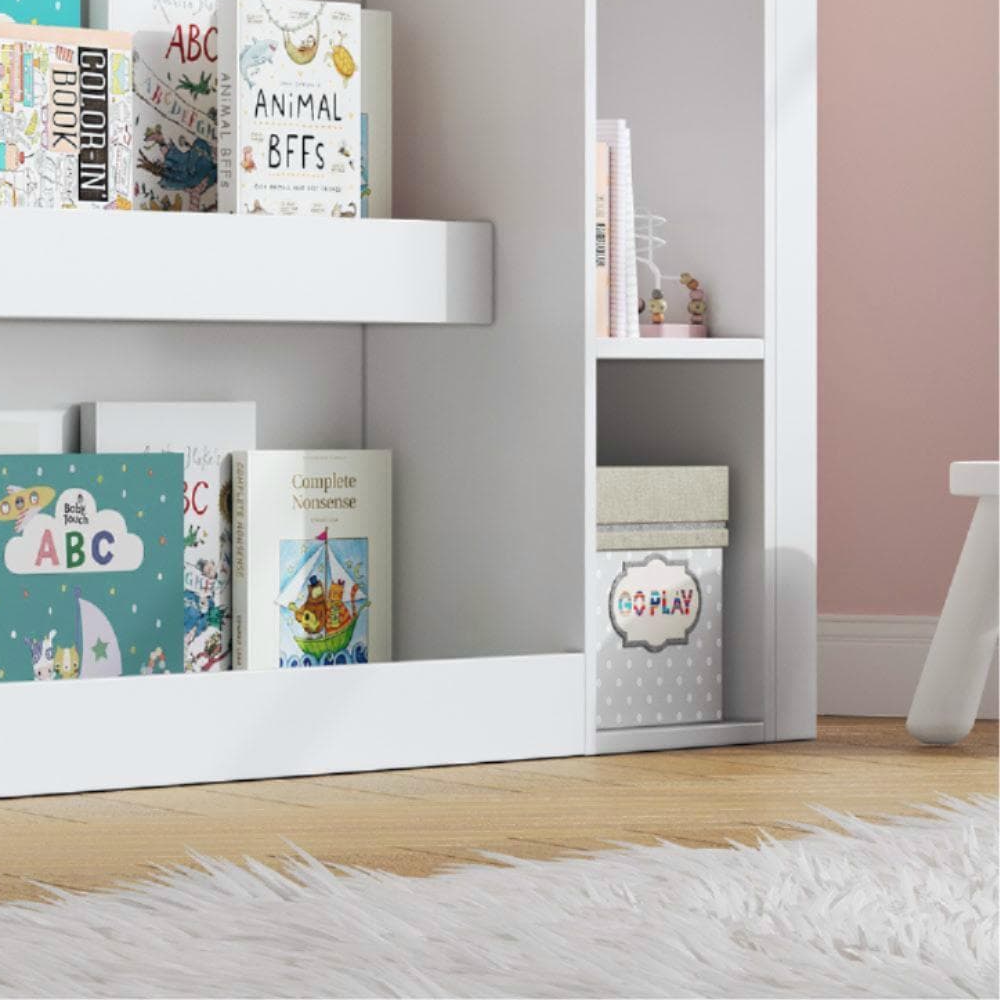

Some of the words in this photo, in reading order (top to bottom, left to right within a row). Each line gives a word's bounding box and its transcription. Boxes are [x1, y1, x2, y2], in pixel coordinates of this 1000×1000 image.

[164, 23, 218, 65] ABC
[52, 69, 78, 150] BOOK
[292, 472, 358, 494] Complete
[63, 502, 87, 517] Baby
[292, 494, 358, 510] Nonsense
[63, 513, 90, 526] Touch
[34, 528, 116, 569] ABC
[617, 589, 646, 617] GO
[649, 589, 694, 617] PLAY
